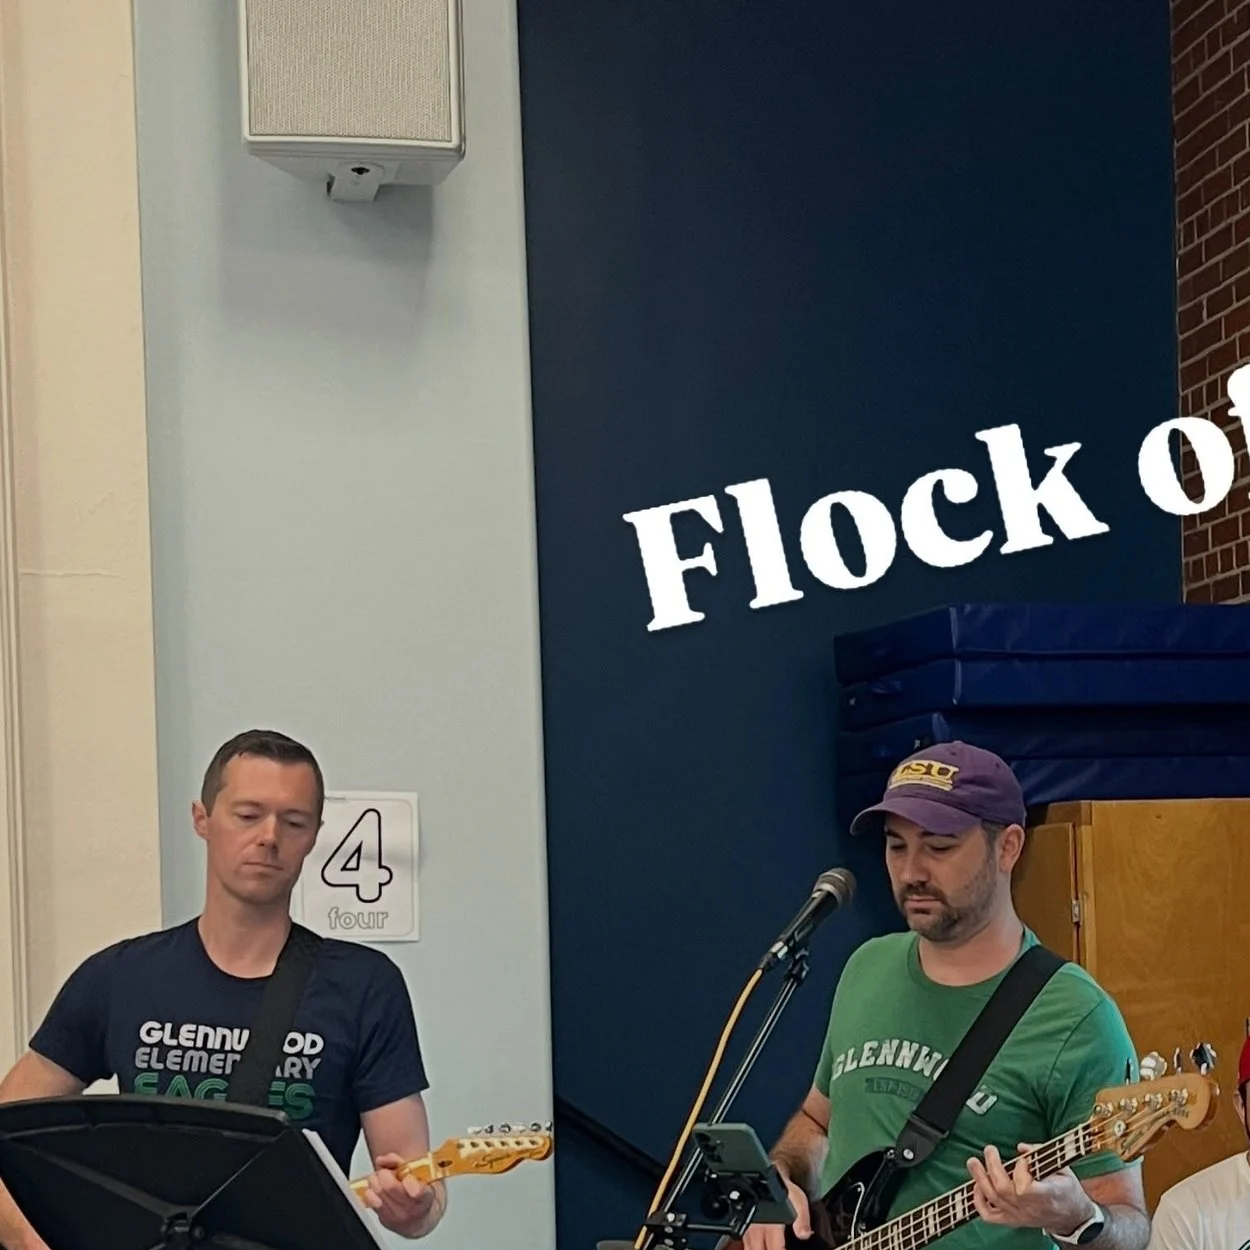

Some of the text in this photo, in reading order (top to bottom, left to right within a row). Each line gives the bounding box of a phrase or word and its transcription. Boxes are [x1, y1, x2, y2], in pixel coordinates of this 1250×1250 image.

[321, 808, 393, 903] 4
[327, 906, 389, 930] four
[832, 1038, 998, 1115] GLENNWD
